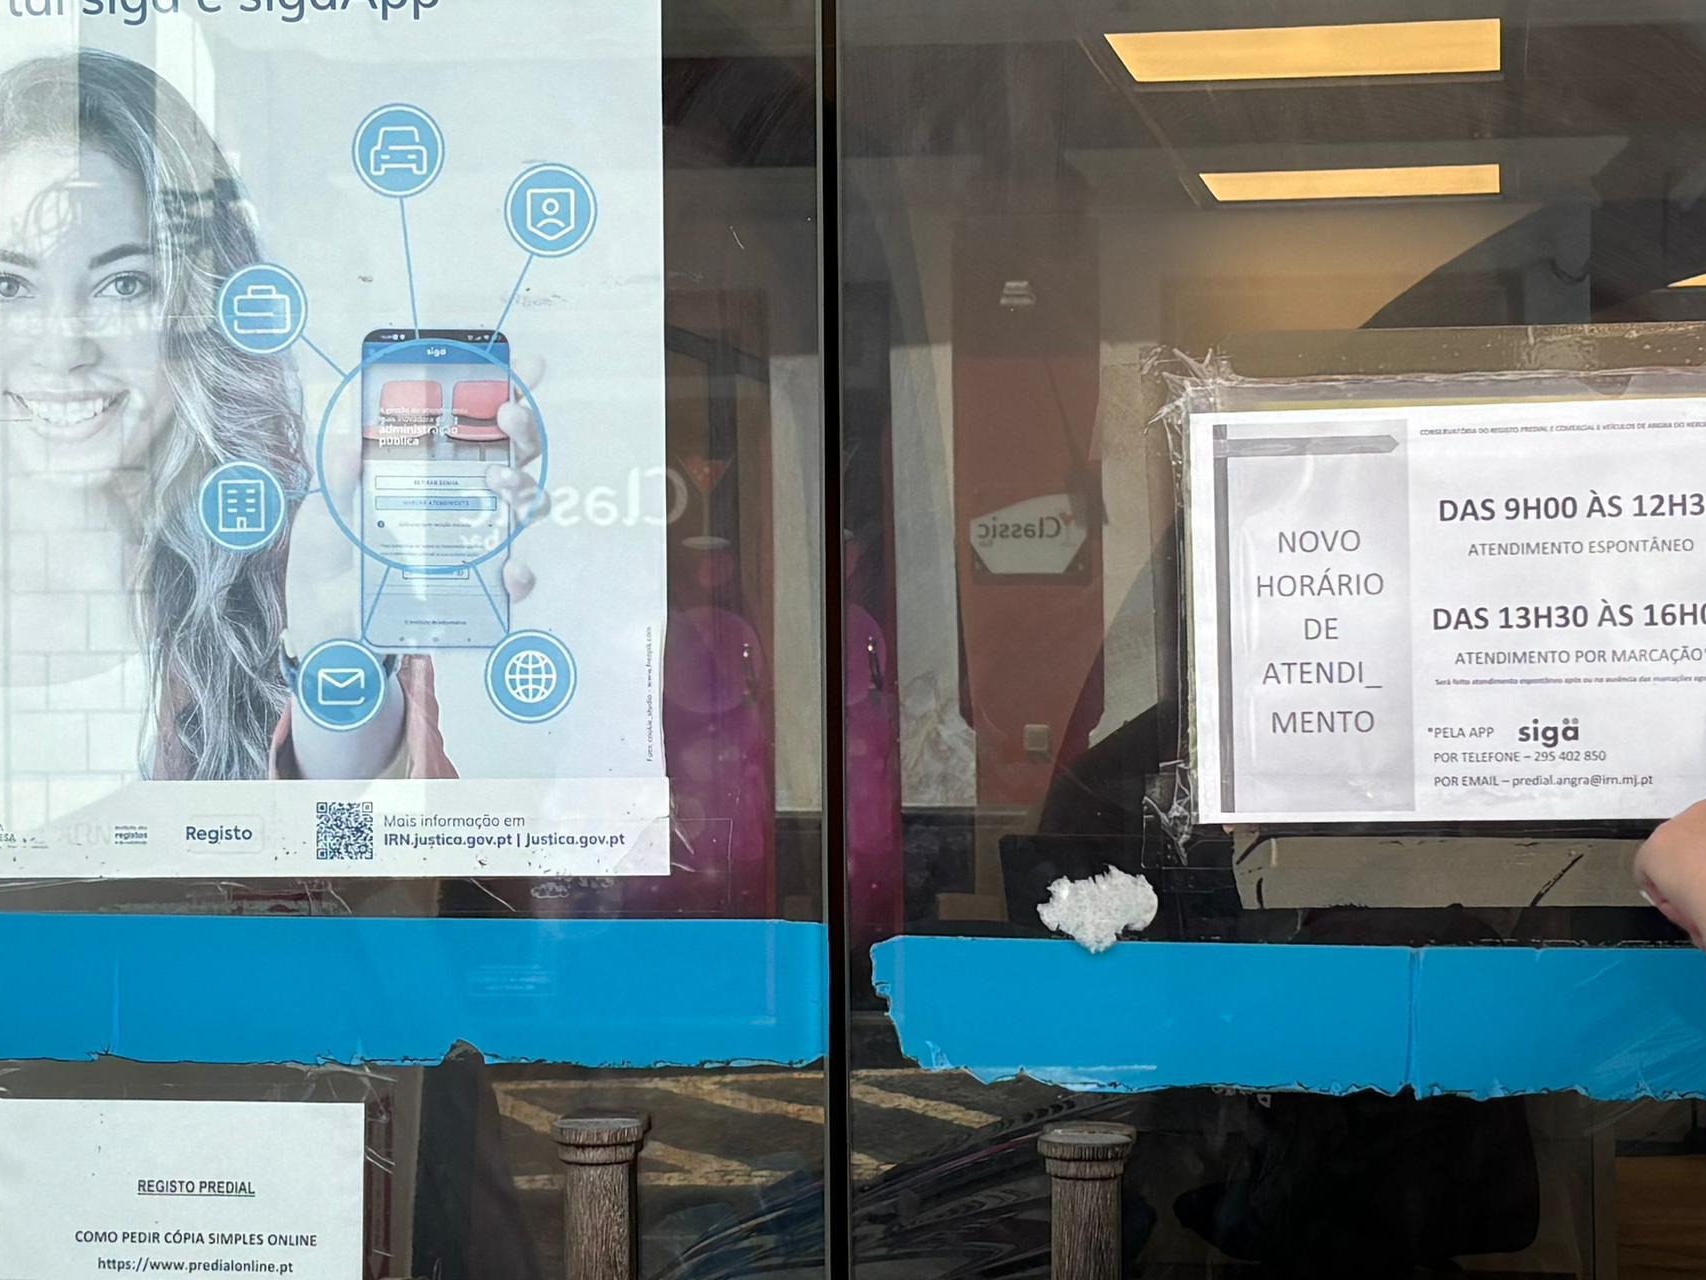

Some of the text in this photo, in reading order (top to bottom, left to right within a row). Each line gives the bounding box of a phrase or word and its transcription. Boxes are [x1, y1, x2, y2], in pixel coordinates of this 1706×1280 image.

[1438, 499, 1496, 522] DAS
[1504, 497, 1578, 521] 9H00
[1587, 489, 1626, 519] ÀS
[1277, 529, 1361, 553] NOVO
[1468, 535, 1695, 556] ATENDIMENTO ESPONTÂNEO
[1256, 567, 1385, 598] HORÁRIO
[1432, 607, 1490, 631] DAS
[1499, 604, 1590, 629] 13H30
[1597, 597, 1636, 628] ÀS
[1303, 617, 1339, 641] DE
[1454, 648, 1571, 666] ATENDIMENTO
[1574, 648, 1607, 665] POR
[1271, 709, 1375, 734] MENTO
[1470, 726, 1495, 738] APP
[1433, 751, 1457, 763] POR
[1461, 750, 1521, 763] TELEFONE
[1534, 750, 1556, 762] 295
[1559, 750, 1581, 762] 402
[1583, 749, 1607, 762] 850
[1433, 775, 1458, 787] POR
[1461, 775, 1499, 787] EMAIL
[383, 814, 526, 831] Mais informação em
[186, 825, 253, 844] Registo
[383, 832, 513, 850] IRN.justica.gov.pt
[137, 1179, 256, 1194] REGISTO PREDIAL
[74, 1228, 318, 1247] COMO PEDIR CÓPIA SIMPLES ONLINE
[97, 1257, 294, 1276] https://www.predialonline.pt
